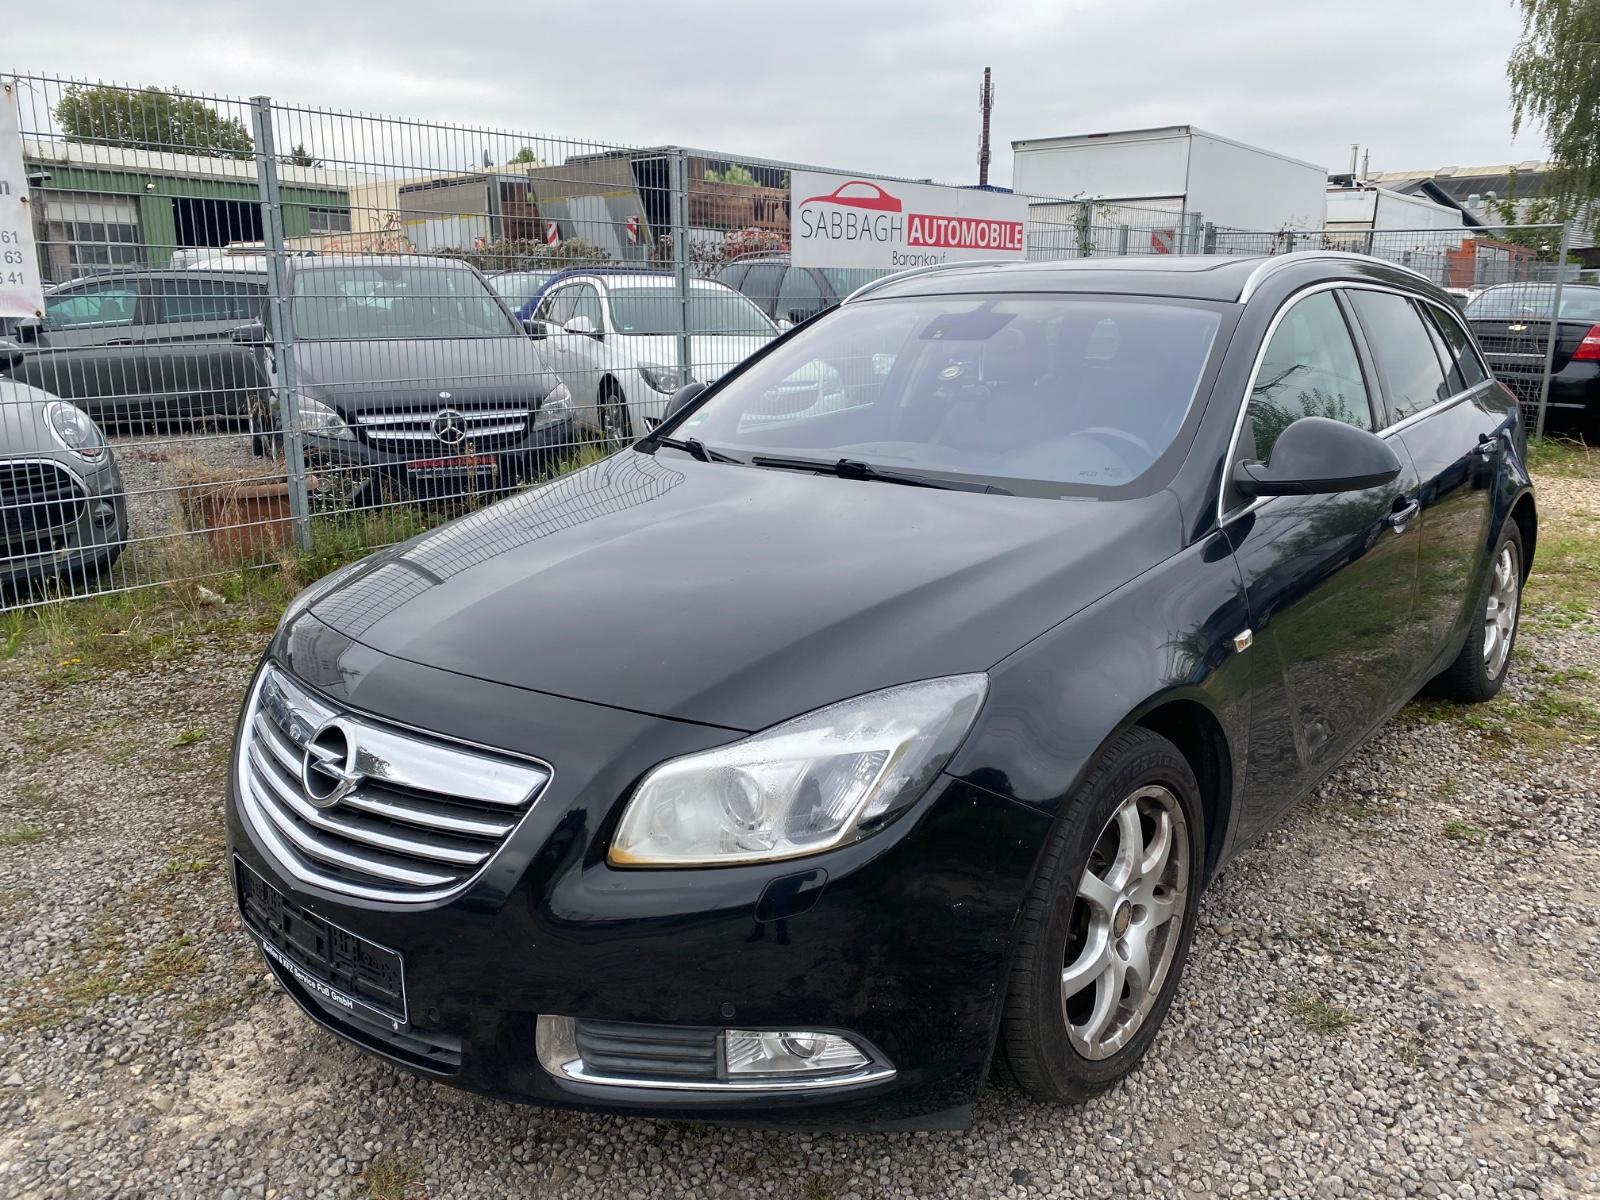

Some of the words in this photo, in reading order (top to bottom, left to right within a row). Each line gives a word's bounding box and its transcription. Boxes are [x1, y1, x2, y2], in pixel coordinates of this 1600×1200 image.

[801, 209, 903, 242] SABBAGH
[908, 217, 1023, 249] AUTOMOBILE
[1, 230, 19, 244] 61
[4, 250, 23, 264] 63
[892, 250, 946, 267] Barankauf
[8, 271, 24, 285] 41
[331, 990, 353, 1009] GmbH
